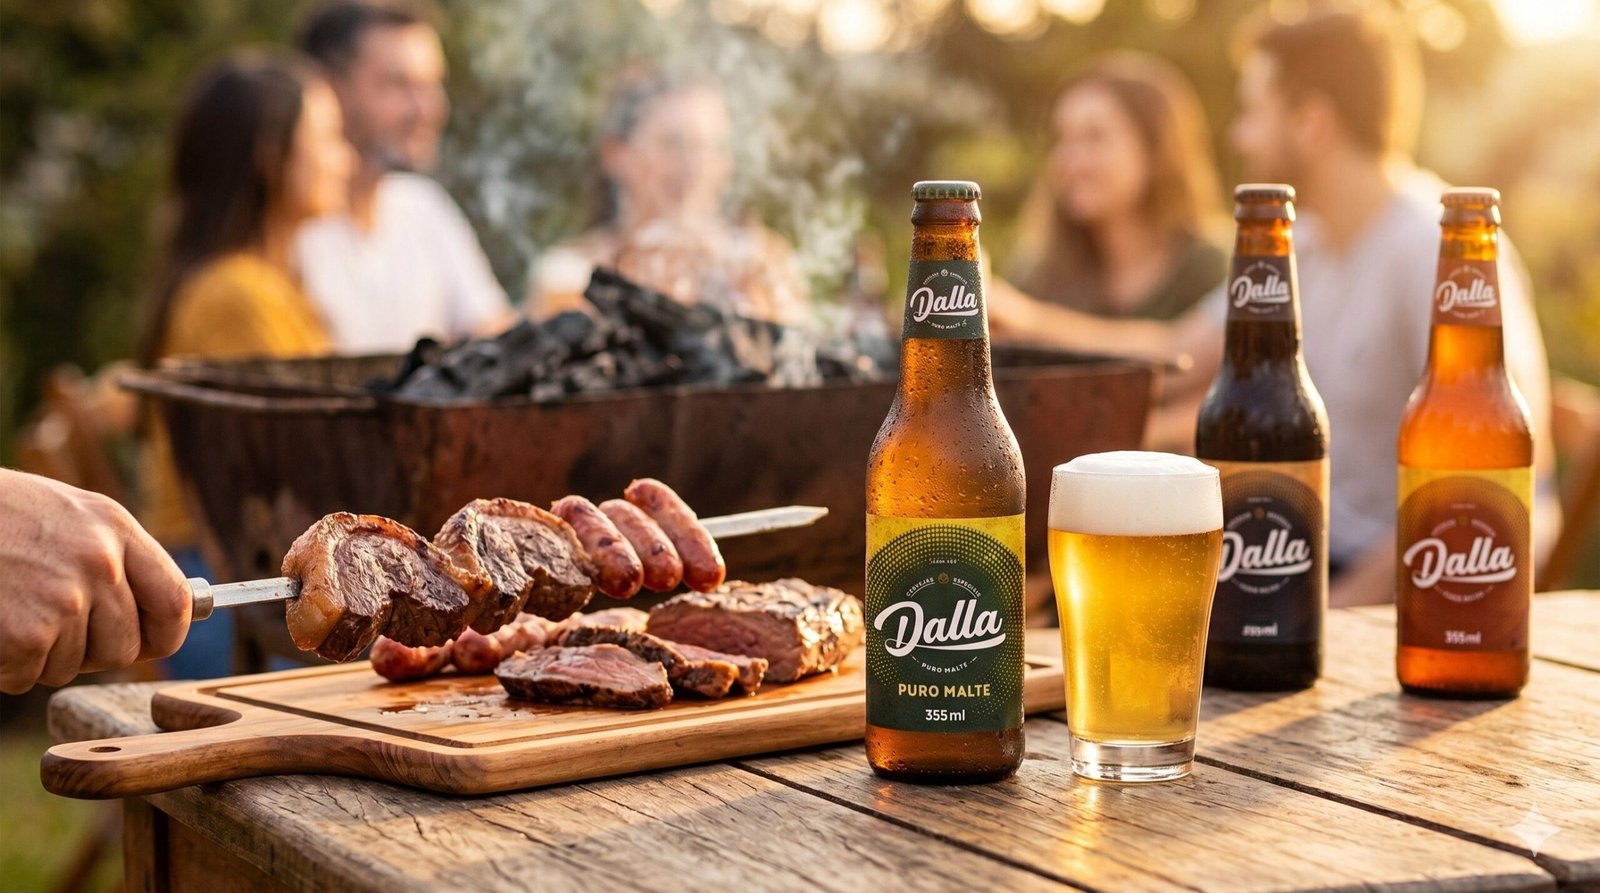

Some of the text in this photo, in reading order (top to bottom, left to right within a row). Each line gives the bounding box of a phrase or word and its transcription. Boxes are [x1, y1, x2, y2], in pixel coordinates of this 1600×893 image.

[909, 285, 979, 322] Dalla
[1230, 274, 1291, 309] Dalla
[1435, 278, 1497, 313] Dalla
[1218, 528, 1313, 583] Dalla
[1403, 536, 1517, 589] Dalla
[874, 599, 1007, 657] Dalla
[921, 662, 968, 673] PURO MALTE
[898, 683, 991, 698] PURO MALTE
